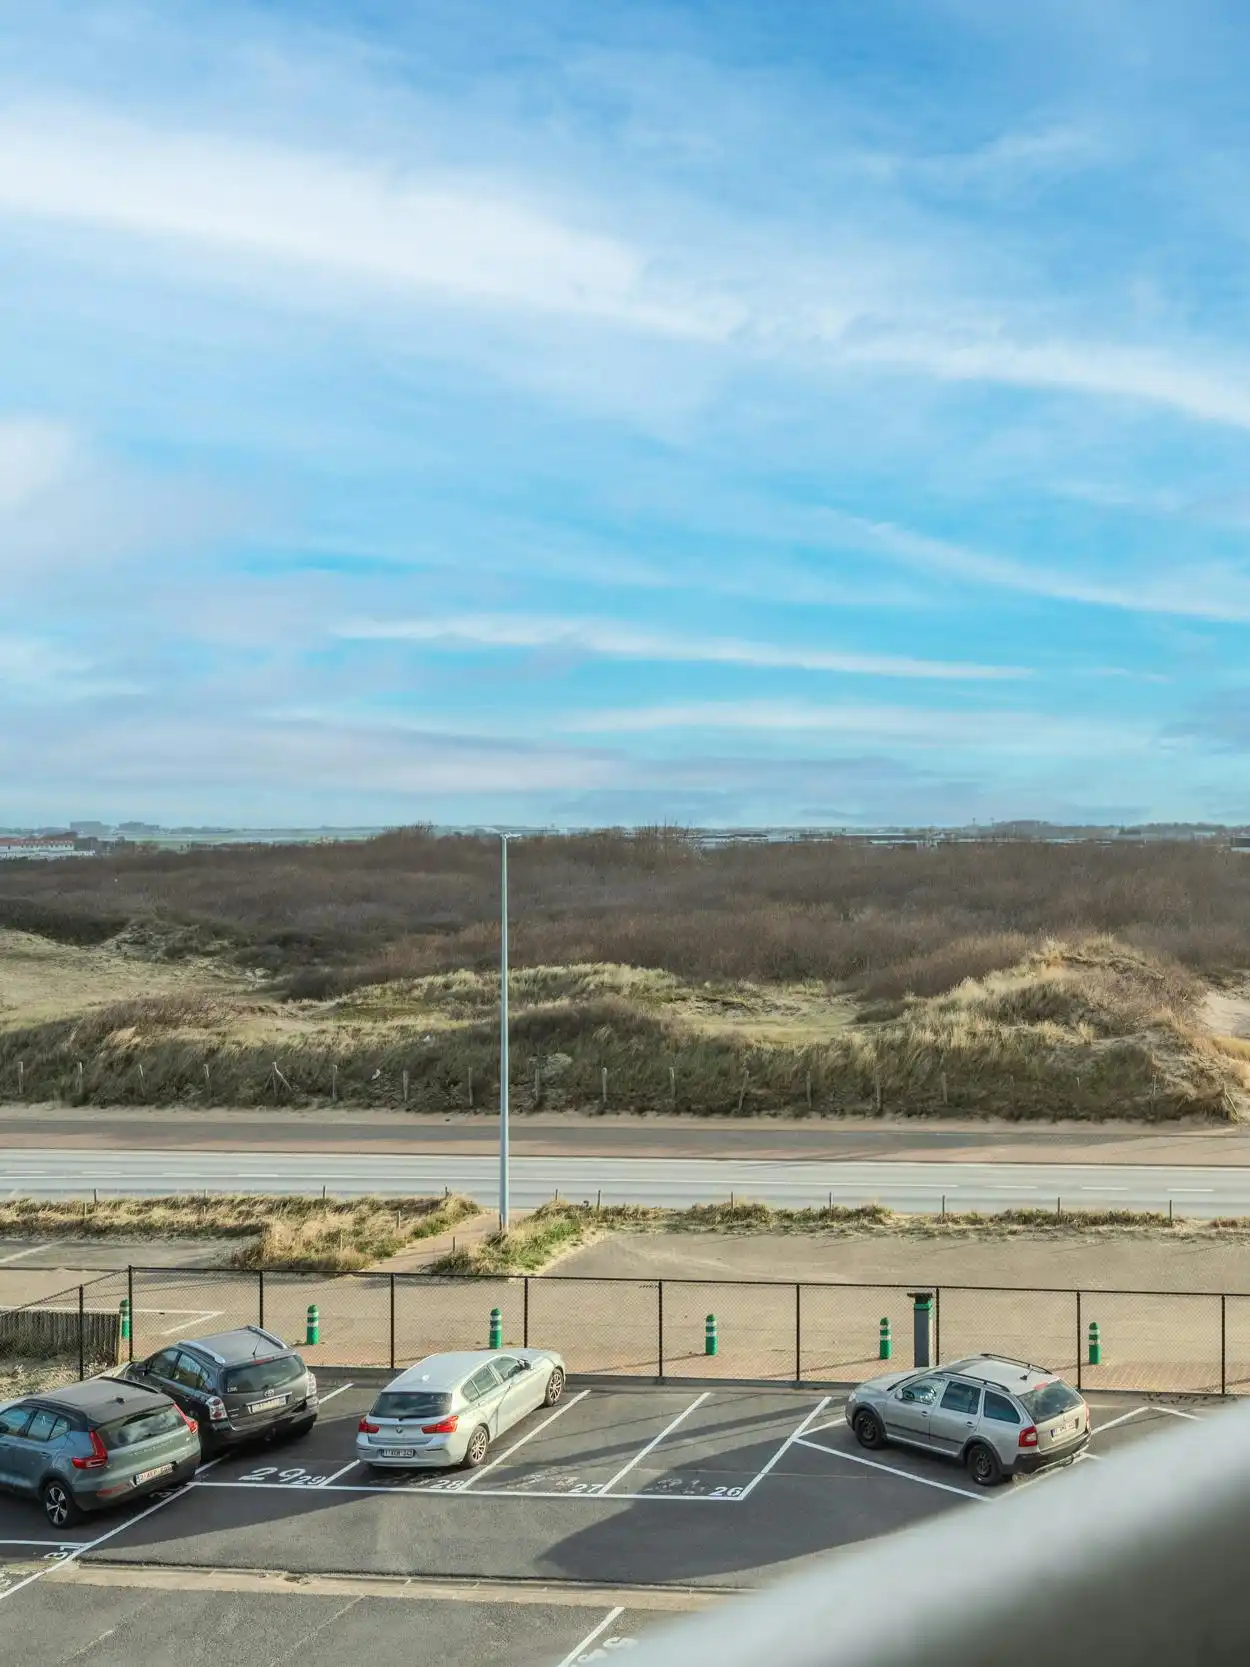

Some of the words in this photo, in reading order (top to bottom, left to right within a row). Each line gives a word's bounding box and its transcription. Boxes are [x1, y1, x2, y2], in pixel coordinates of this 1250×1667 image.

[238, 1467, 307, 1482] 29
[428, 1480, 465, 1489] 28
[568, 1483, 604, 1493] 27
[708, 1487, 744, 1497] 26
